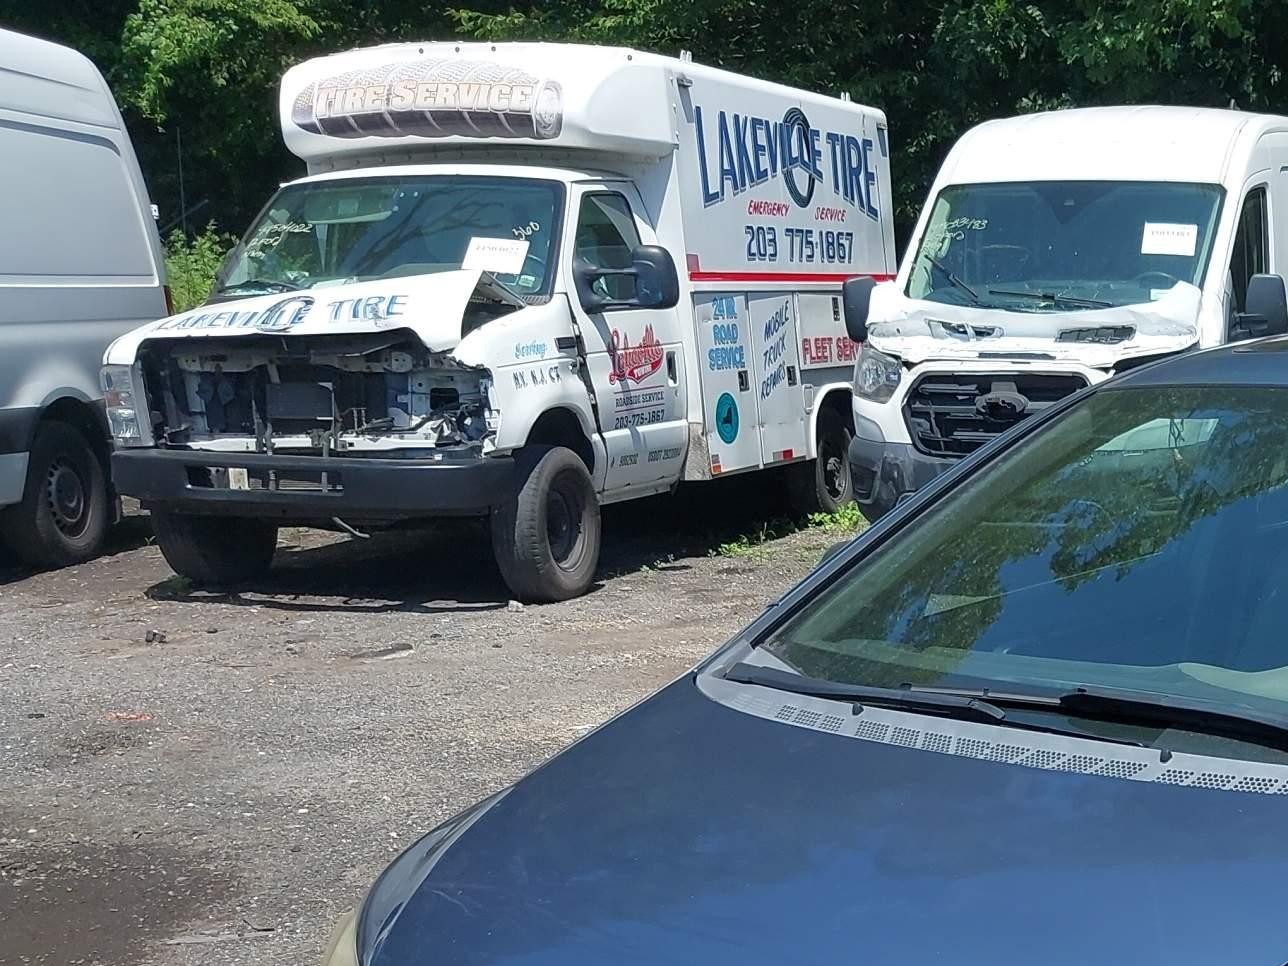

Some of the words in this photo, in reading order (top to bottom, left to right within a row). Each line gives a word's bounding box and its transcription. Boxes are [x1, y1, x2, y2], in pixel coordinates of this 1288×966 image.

[317, 84, 386, 115] TIRE
[391, 79, 533, 113] SERVICE
[694, 105, 823, 208] LAKEVILLE
[826, 131, 879, 222] TIRE
[748, 200, 790, 216] EMERGENCY
[815, 207, 847, 222] SERVICE
[745, 226, 778, 262] 203
[327, 295, 409, 322] TIRE
[763, 300, 790, 343] MOBILE
[713, 323, 739, 346] ROAD
[708, 346, 745, 371] SERVICE
[763, 331, 787, 371] TRUCK
[802, 337, 833, 365] FLEET
[760, 360, 786, 400] REPAIRS
[641, 391, 664, 404] SERVICE
